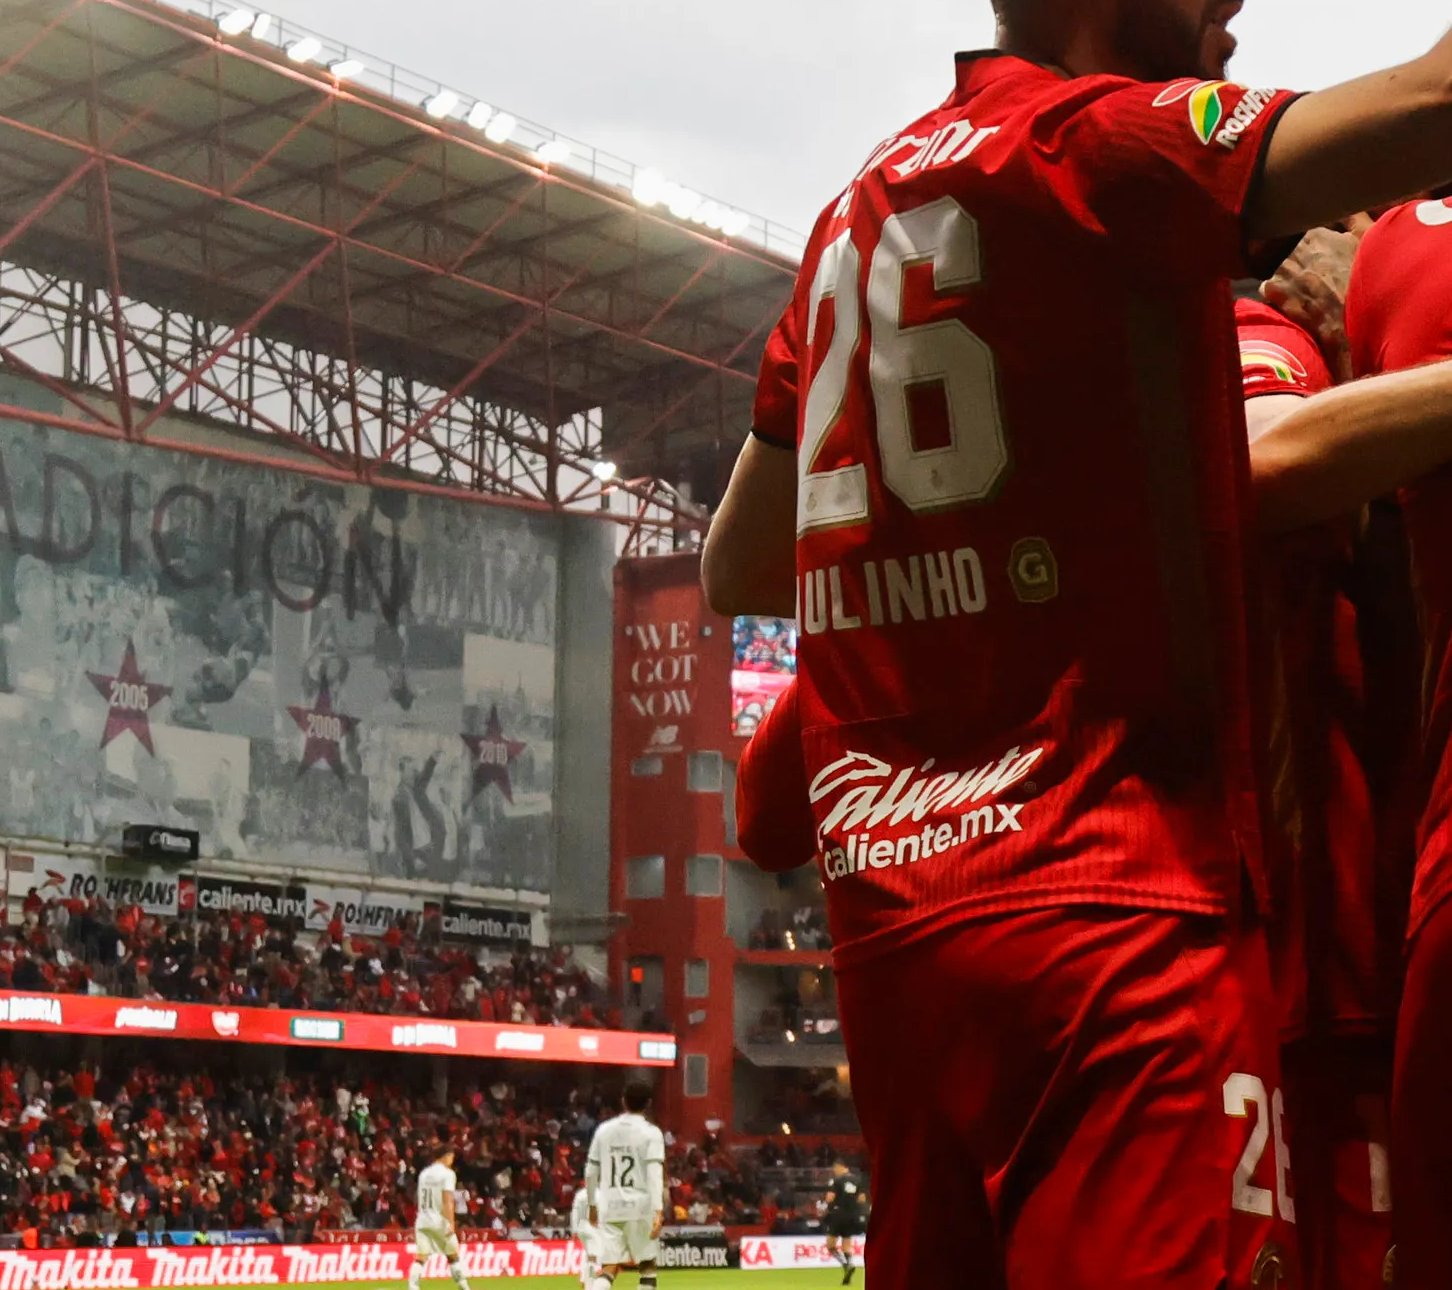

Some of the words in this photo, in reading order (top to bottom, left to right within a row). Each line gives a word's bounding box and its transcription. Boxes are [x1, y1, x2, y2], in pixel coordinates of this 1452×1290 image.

[1215, 87, 1278, 150] ROSHF
[797, 195, 1010, 541] 26
[796, 547, 988, 637] ULINHO
[636, 621, 690, 650] WE
[631, 654, 697, 685] GOT
[110, 681, 148, 710] 2005
[809, 746, 1044, 839] Caliente
[824, 802, 1024, 881] caliente.mx
[70, 874, 176, 906] ROHFRANS
[199, 885, 306, 917] caliente.mx
[610, 1156, 634, 1188] 12
[656, 1241, 728, 1267] liente.mx
